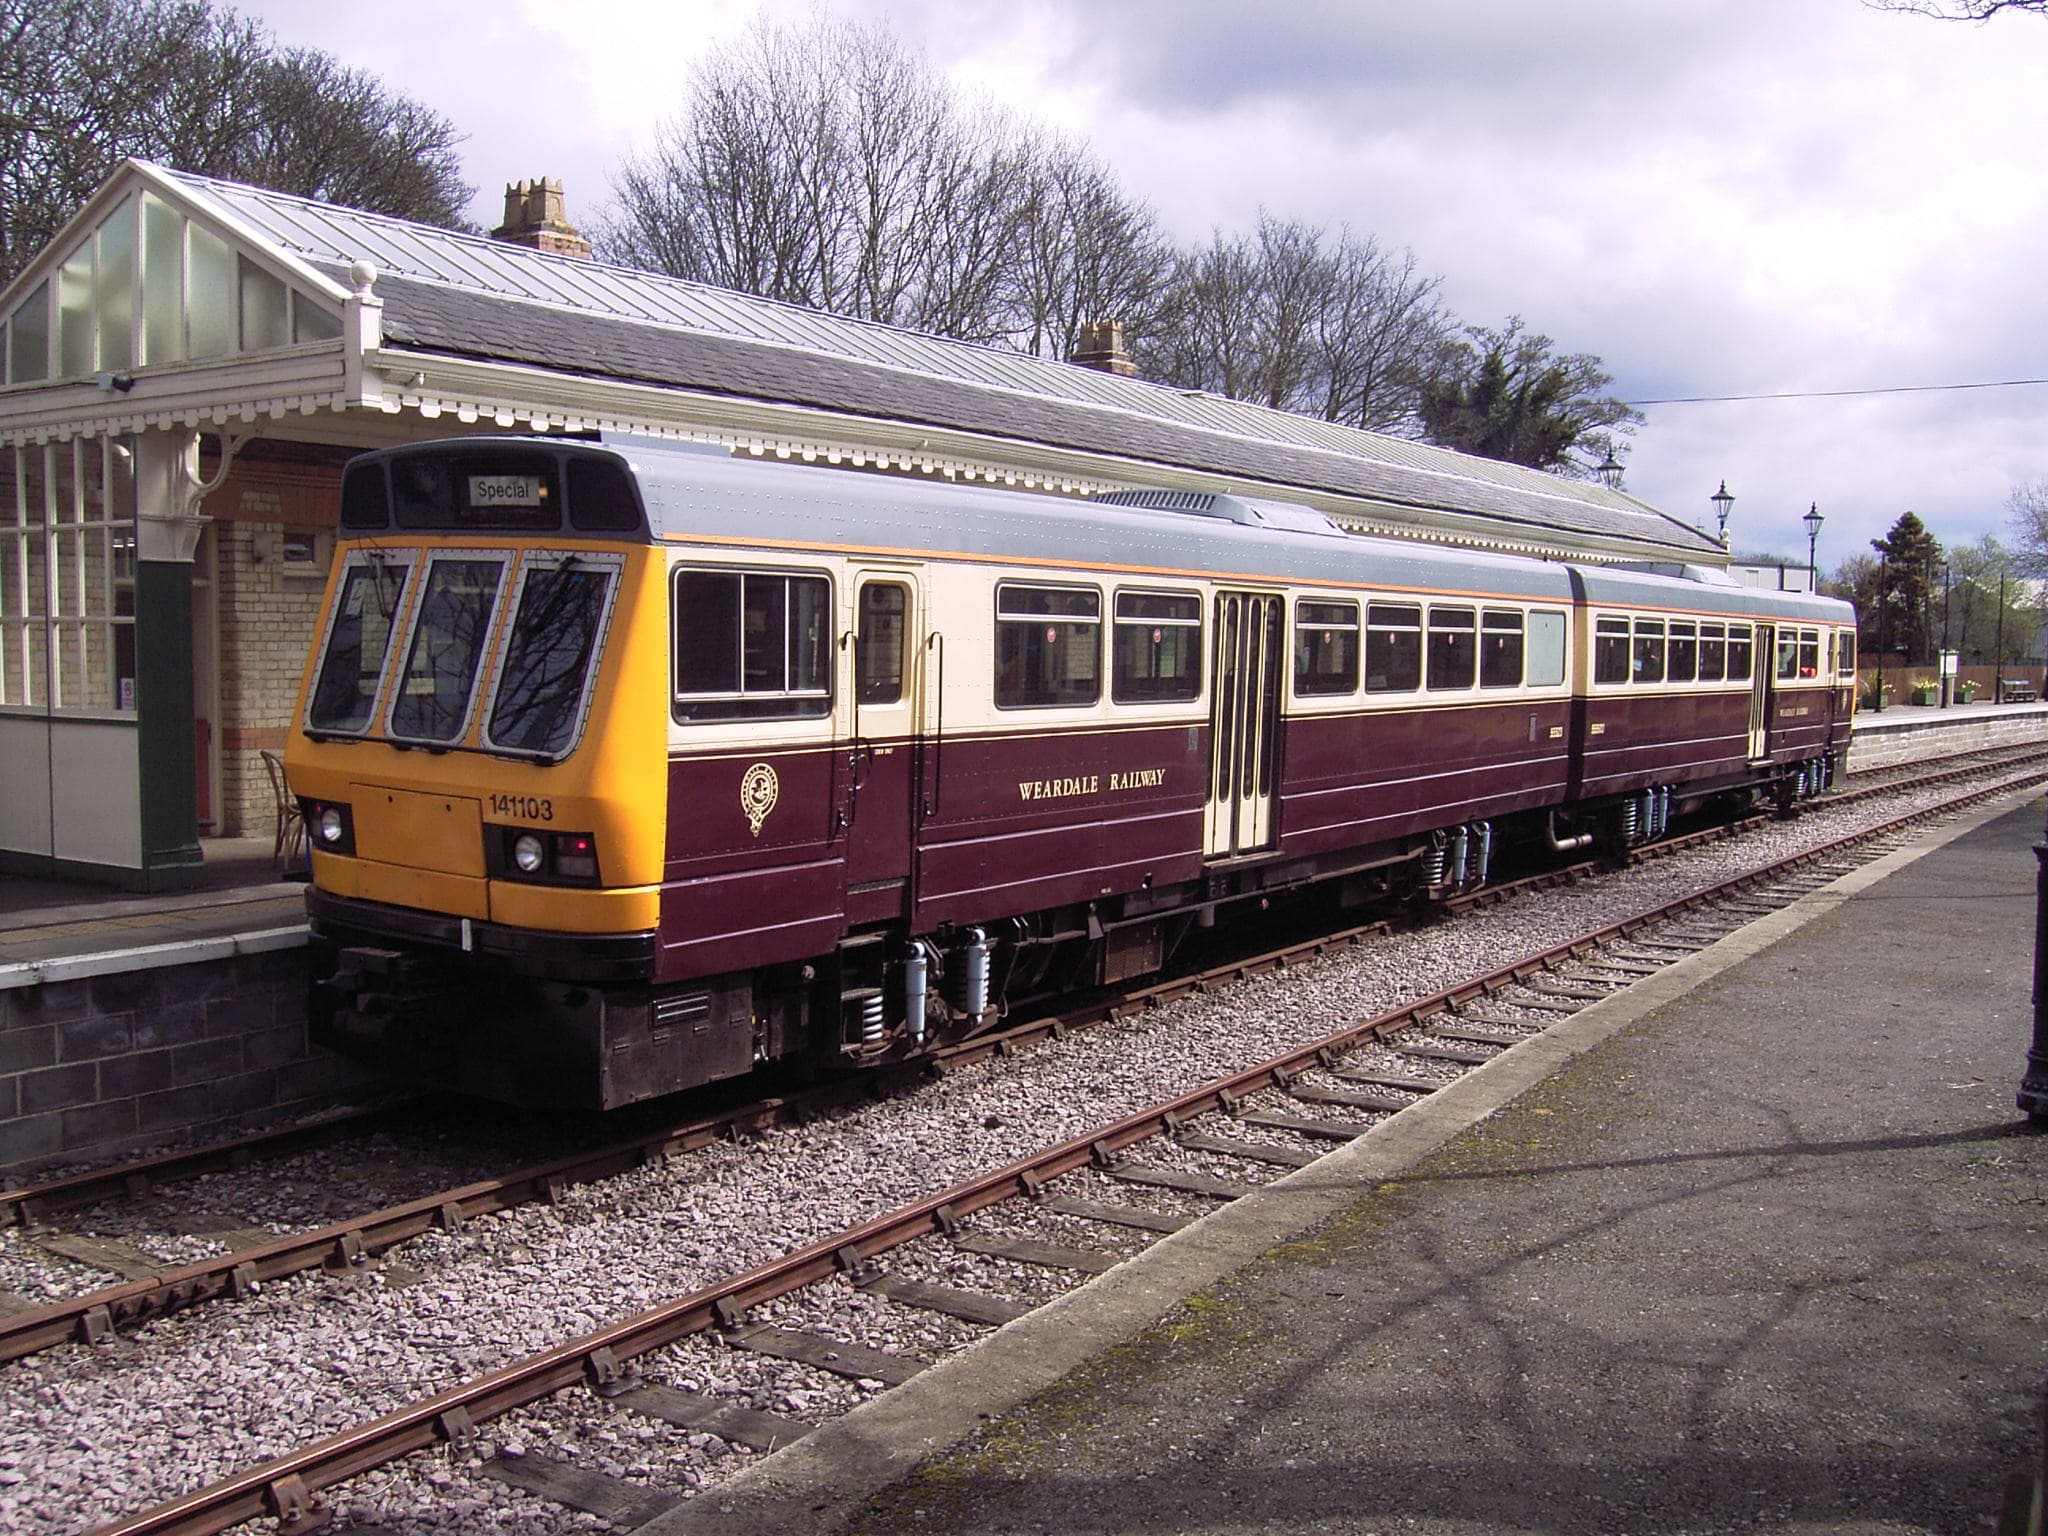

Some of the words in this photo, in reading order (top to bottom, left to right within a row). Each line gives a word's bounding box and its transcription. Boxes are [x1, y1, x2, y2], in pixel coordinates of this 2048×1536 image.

[478, 481, 529, 501] Special
[1019, 775, 1099, 801] WEARDALE
[1109, 768, 1166, 791] RAILWAY
[489, 794, 553, 821] 141103
